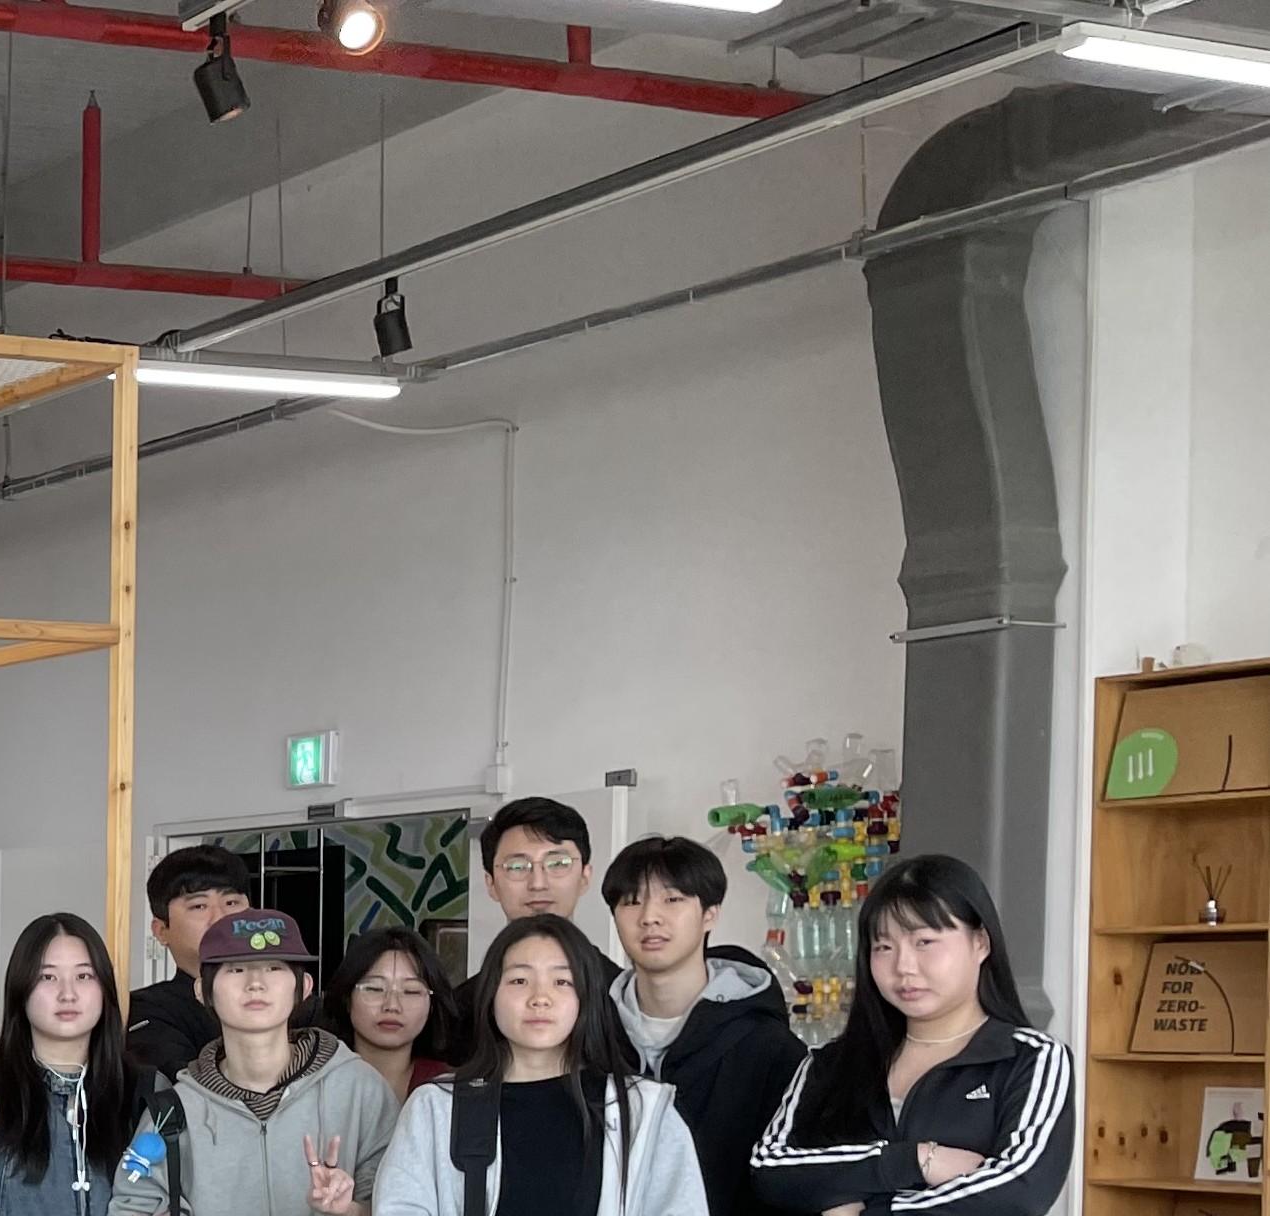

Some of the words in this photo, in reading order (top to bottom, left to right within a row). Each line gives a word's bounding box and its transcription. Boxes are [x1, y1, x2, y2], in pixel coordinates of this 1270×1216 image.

[232, 918, 286, 934] Pecan
[1161, 981, 1194, 994] FOR
[1156, 1000, 1206, 1013] ZERO-
[1153, 1018, 1208, 1032] WASTE
